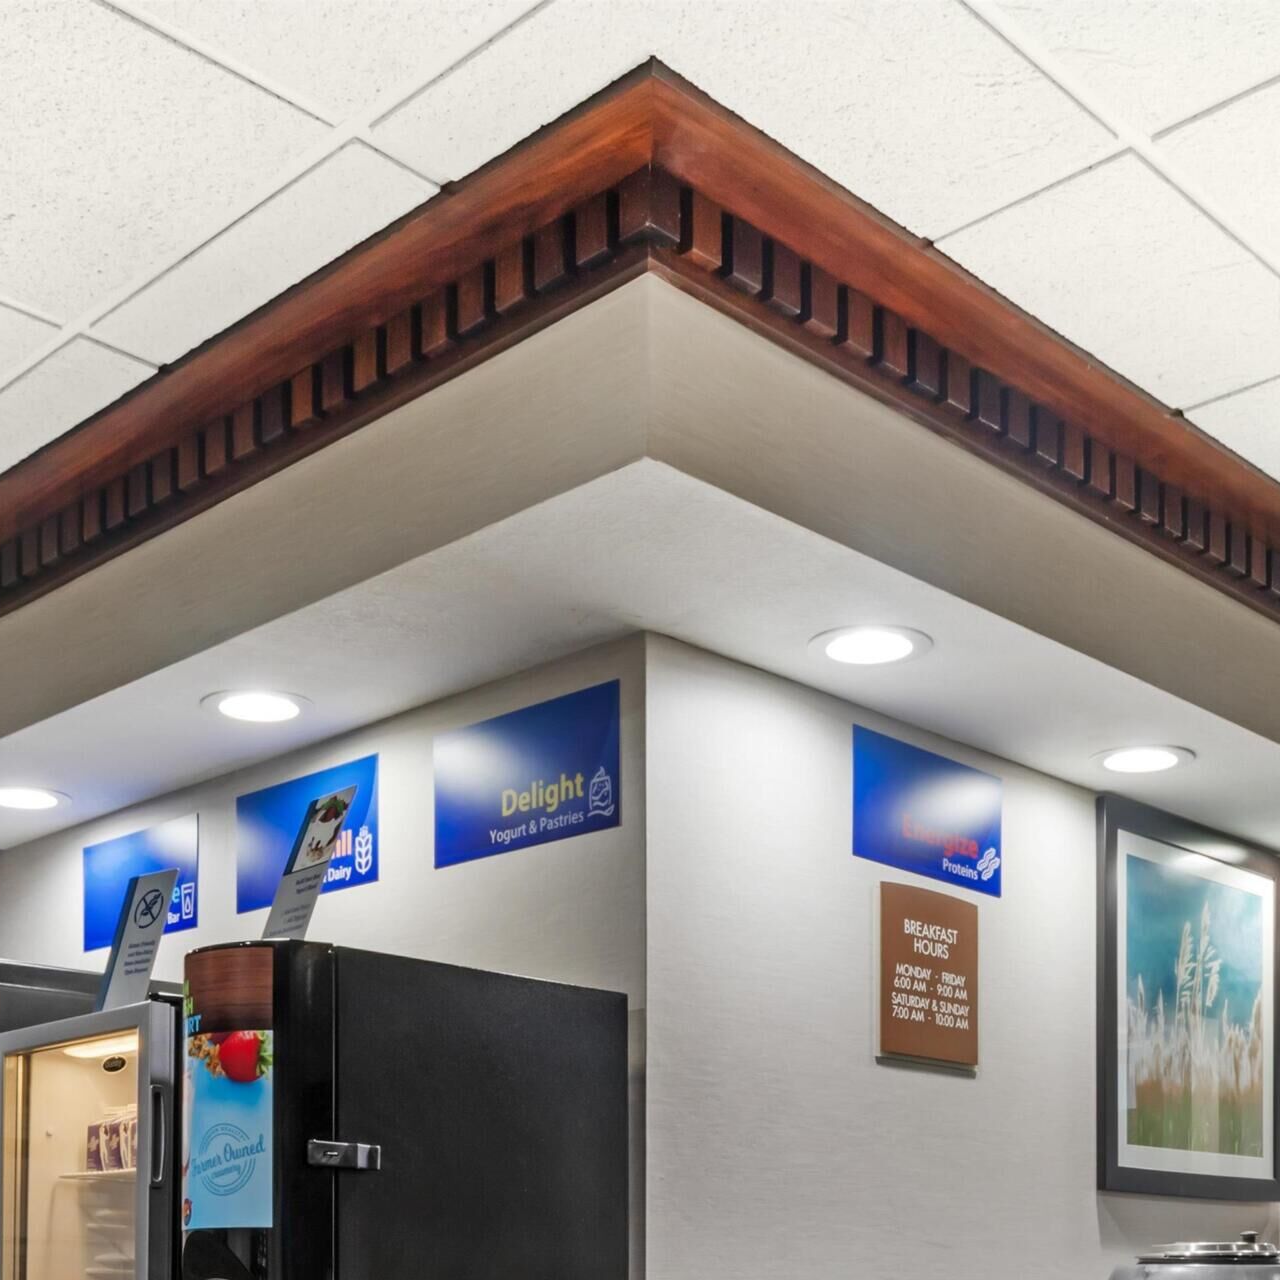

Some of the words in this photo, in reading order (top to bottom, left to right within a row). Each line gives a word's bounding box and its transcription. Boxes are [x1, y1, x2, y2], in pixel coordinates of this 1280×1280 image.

[502, 772, 584, 816] Delight
[489, 824, 527, 844] Yogurt
[529, 820, 537, 834] &
[540, 811, 584, 832] Pastries
[327, 866, 352, 881] Dairy
[942, 858, 978, 880] Proteins
[167, 912, 180, 925] Bar
[904, 918, 958, 944] BREAKFAST
[914, 938, 949, 959] HOURS
[896, 963, 932, 980] MONDAY
[941, 971, 966, 987] FRIDAY
[894, 976, 911, 990] 6:00
[913, 979, 926, 992] AM
[936, 984, 953, 998] 9:00
[954, 988, 968, 1000] AM
[891, 991, 930, 1010] SATURDAY
[932, 999, 938, 1012] &
[939, 1000, 970, 1017] SUNDAY
[892, 1005, 909, 1020] 7:00
[910, 1009, 925, 1023] AM
[935, 1013, 954, 1028] 10:00
[955, 1018, 969, 1030] AM
[224, 1133, 266, 1162] Owned
